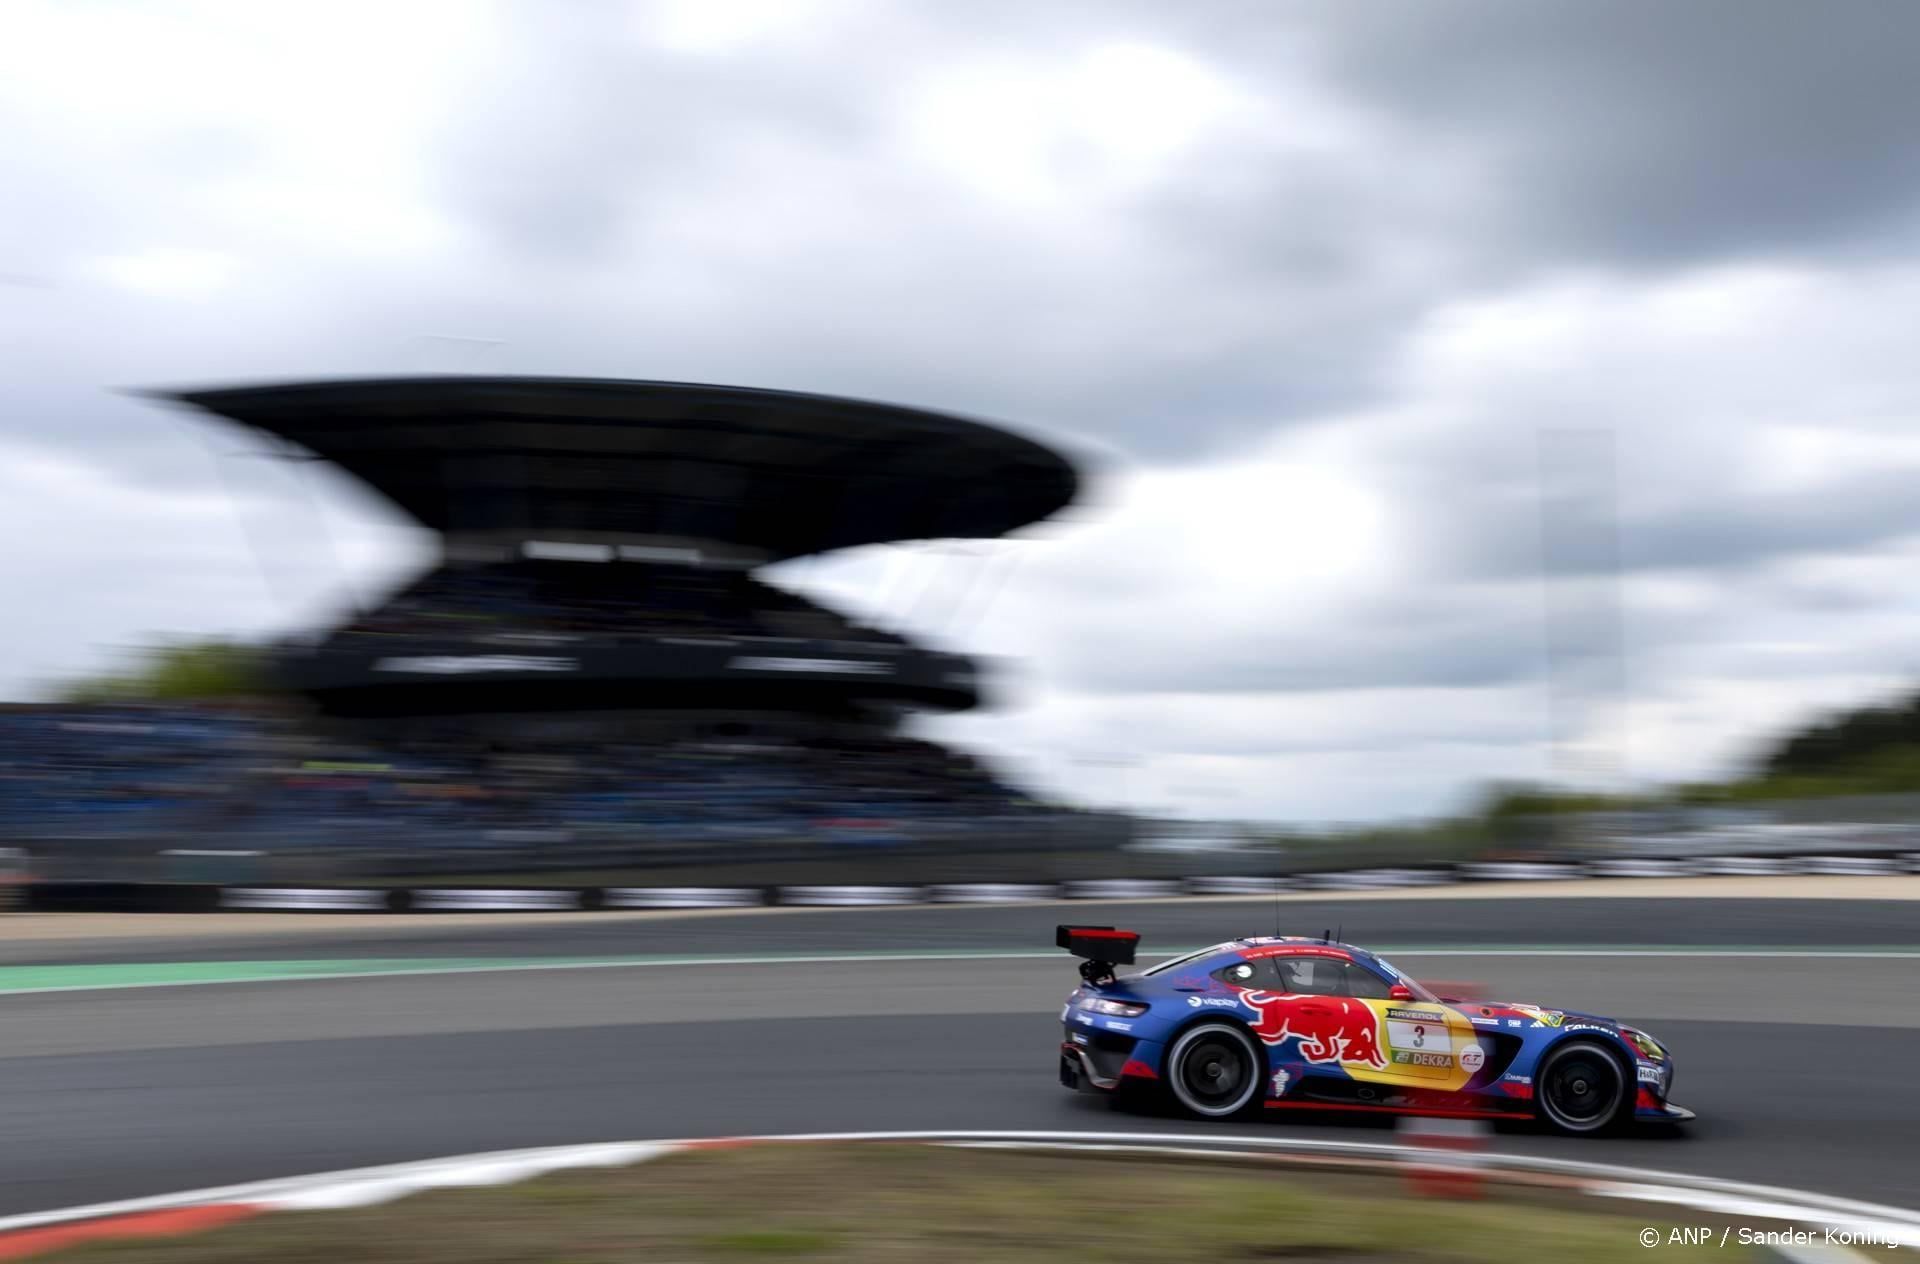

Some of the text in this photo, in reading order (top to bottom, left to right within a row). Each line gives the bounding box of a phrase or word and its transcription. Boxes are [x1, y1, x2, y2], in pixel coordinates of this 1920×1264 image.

[1390, 1010, 1440, 1020] RAVENOL
[1413, 1025, 1425, 1048] 3
[1413, 1053, 1453, 1067] DEKRA
